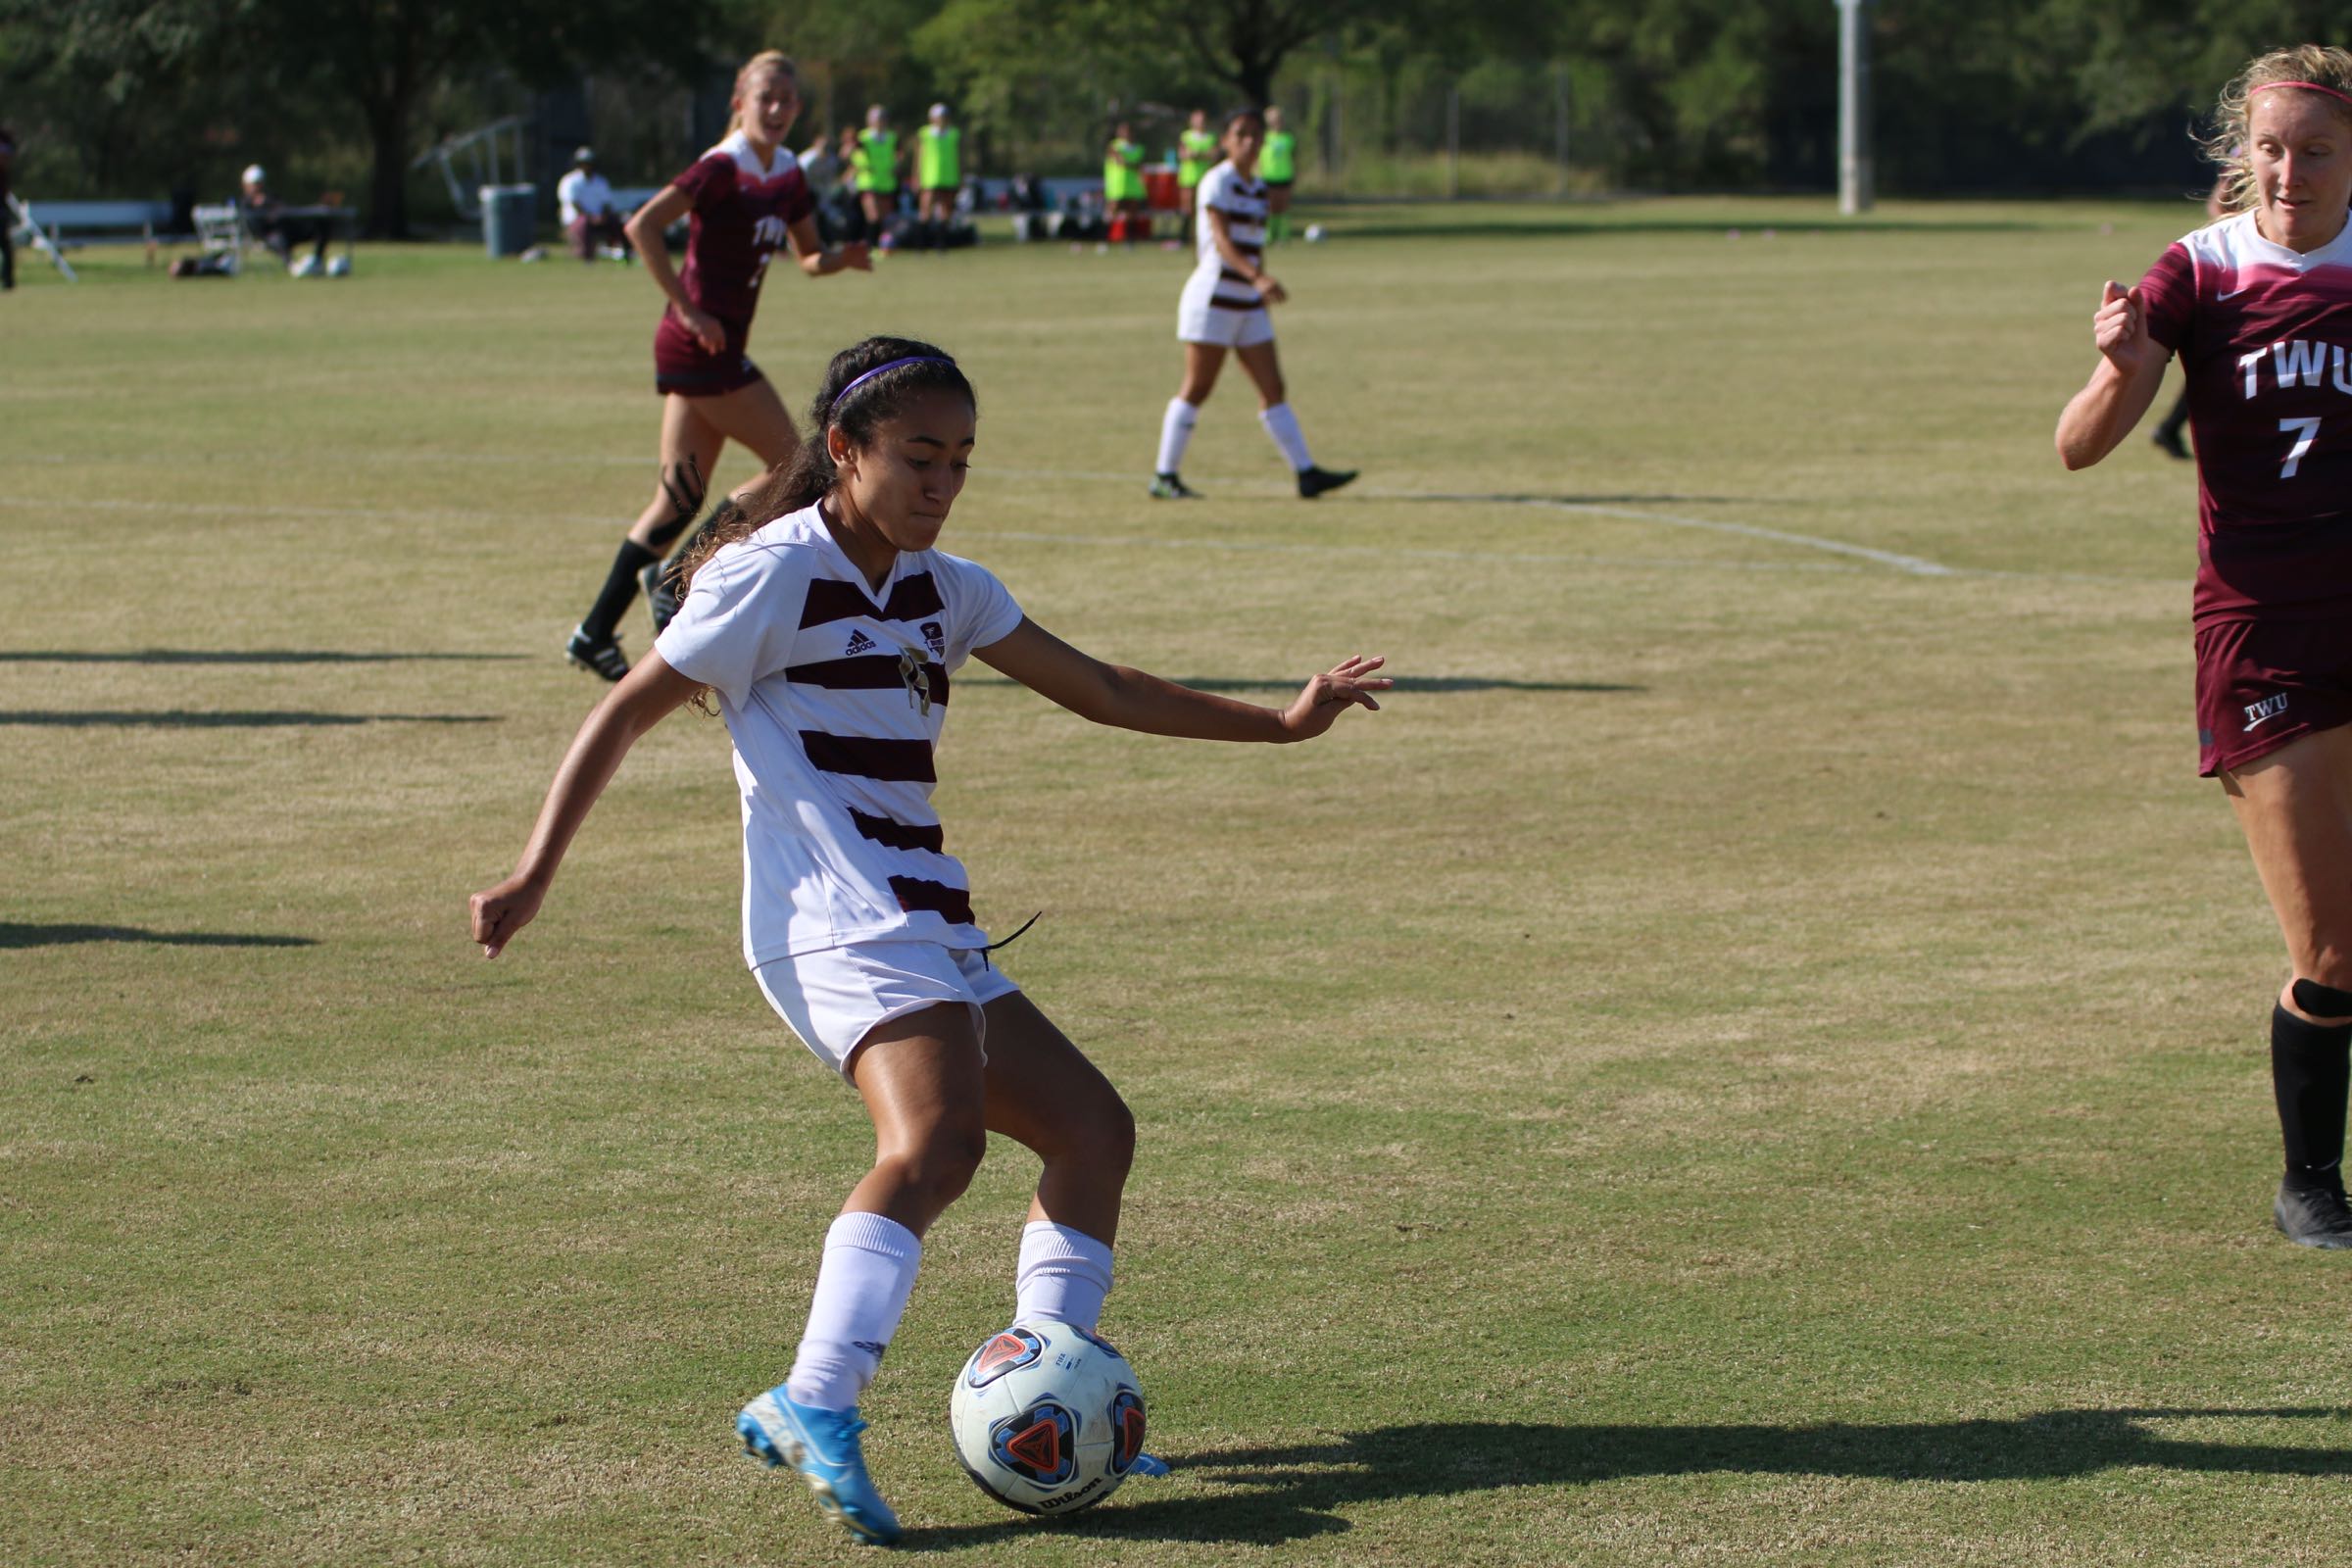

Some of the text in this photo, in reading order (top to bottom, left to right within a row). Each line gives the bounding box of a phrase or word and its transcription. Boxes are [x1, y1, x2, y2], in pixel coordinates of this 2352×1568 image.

[2238, 340, 2352, 400] TWU
[2278, 416, 2322, 478] 7
[846, 640, 877, 657] adidas
[2244, 692, 2288, 721] TWU
[1055, 1352, 1066, 1366] FIFA
[1038, 1477, 1103, 1509] Wilson
